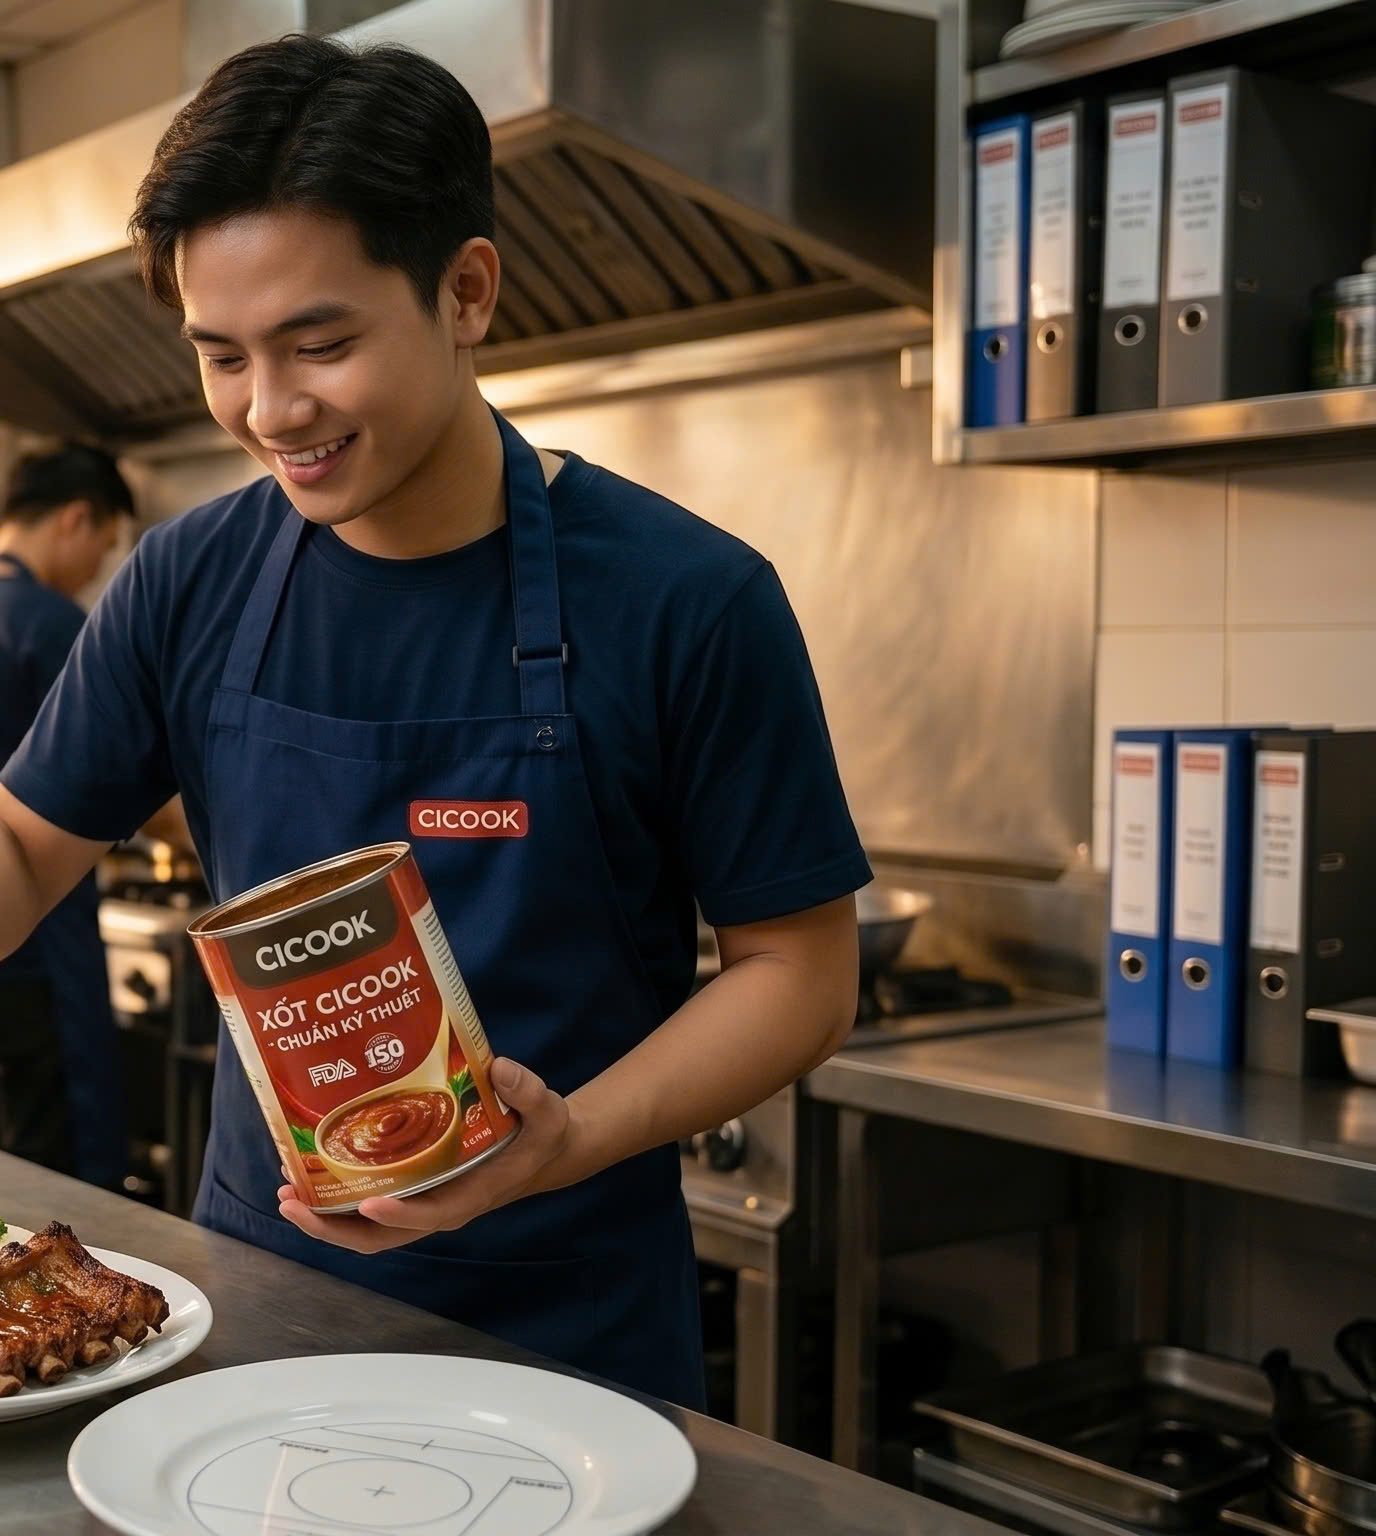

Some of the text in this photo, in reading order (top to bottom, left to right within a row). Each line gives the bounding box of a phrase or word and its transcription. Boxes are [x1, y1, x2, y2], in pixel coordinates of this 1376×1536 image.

[418, 808, 520, 830] CICOOK
[255, 910, 376, 972] CICOOK
[256, 996, 307, 1032] XỐT
[316, 955, 419, 1014] CICOOK
[308, 1058, 357, 1088] FDA
[364, 1038, 405, 1069] ISO
